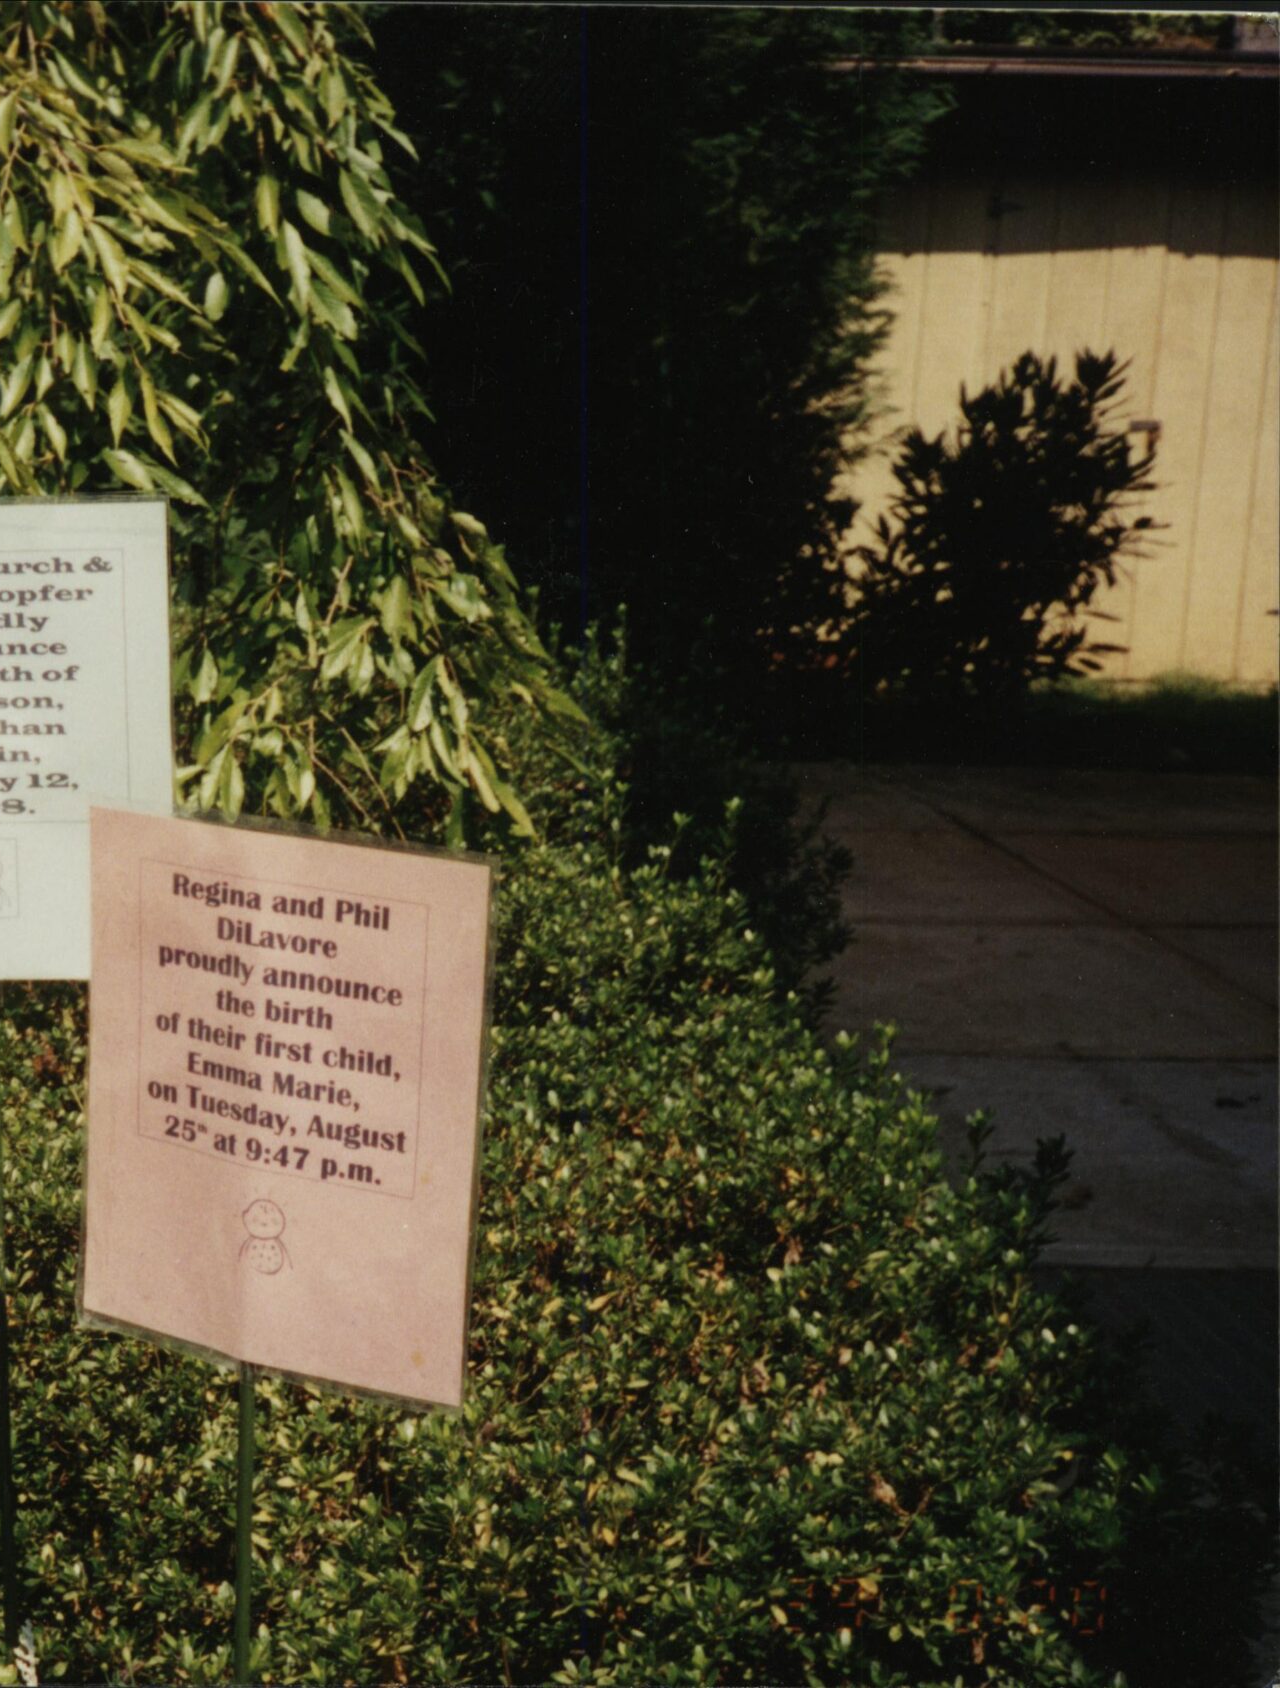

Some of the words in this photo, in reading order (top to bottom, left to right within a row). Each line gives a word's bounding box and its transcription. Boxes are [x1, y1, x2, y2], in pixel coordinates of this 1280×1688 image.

[82, 555, 113, 574] &
[41, 665, 80, 682] of
[28, 772, 79, 791] 12,
[172, 872, 262, 911] Regina
[271, 895, 325, 920] and
[335, 899, 390, 931] Phil
[216, 916, 338, 959] DiLavore
[158, 945, 254, 986] proudly
[262, 967, 403, 1008] announce
[215, 989, 255, 1018] the
[264, 998, 334, 1031] birth
[155, 1011, 181, 1035] of
[187, 1017, 247, 1051] their
[254, 1032, 313, 1064] first
[321, 1045, 401, 1082] child,
[186, 1051, 264, 1092] Emma
[272, 1071, 360, 1113] Marie,
[147, 1080, 178, 1104] on
[186, 1084, 298, 1137] Tuesday,
[306, 1114, 407, 1154] August
[213, 1133, 237, 1156] at
[245, 1137, 311, 1171] 9:47
[320, 1157, 382, 1186] p.m.
